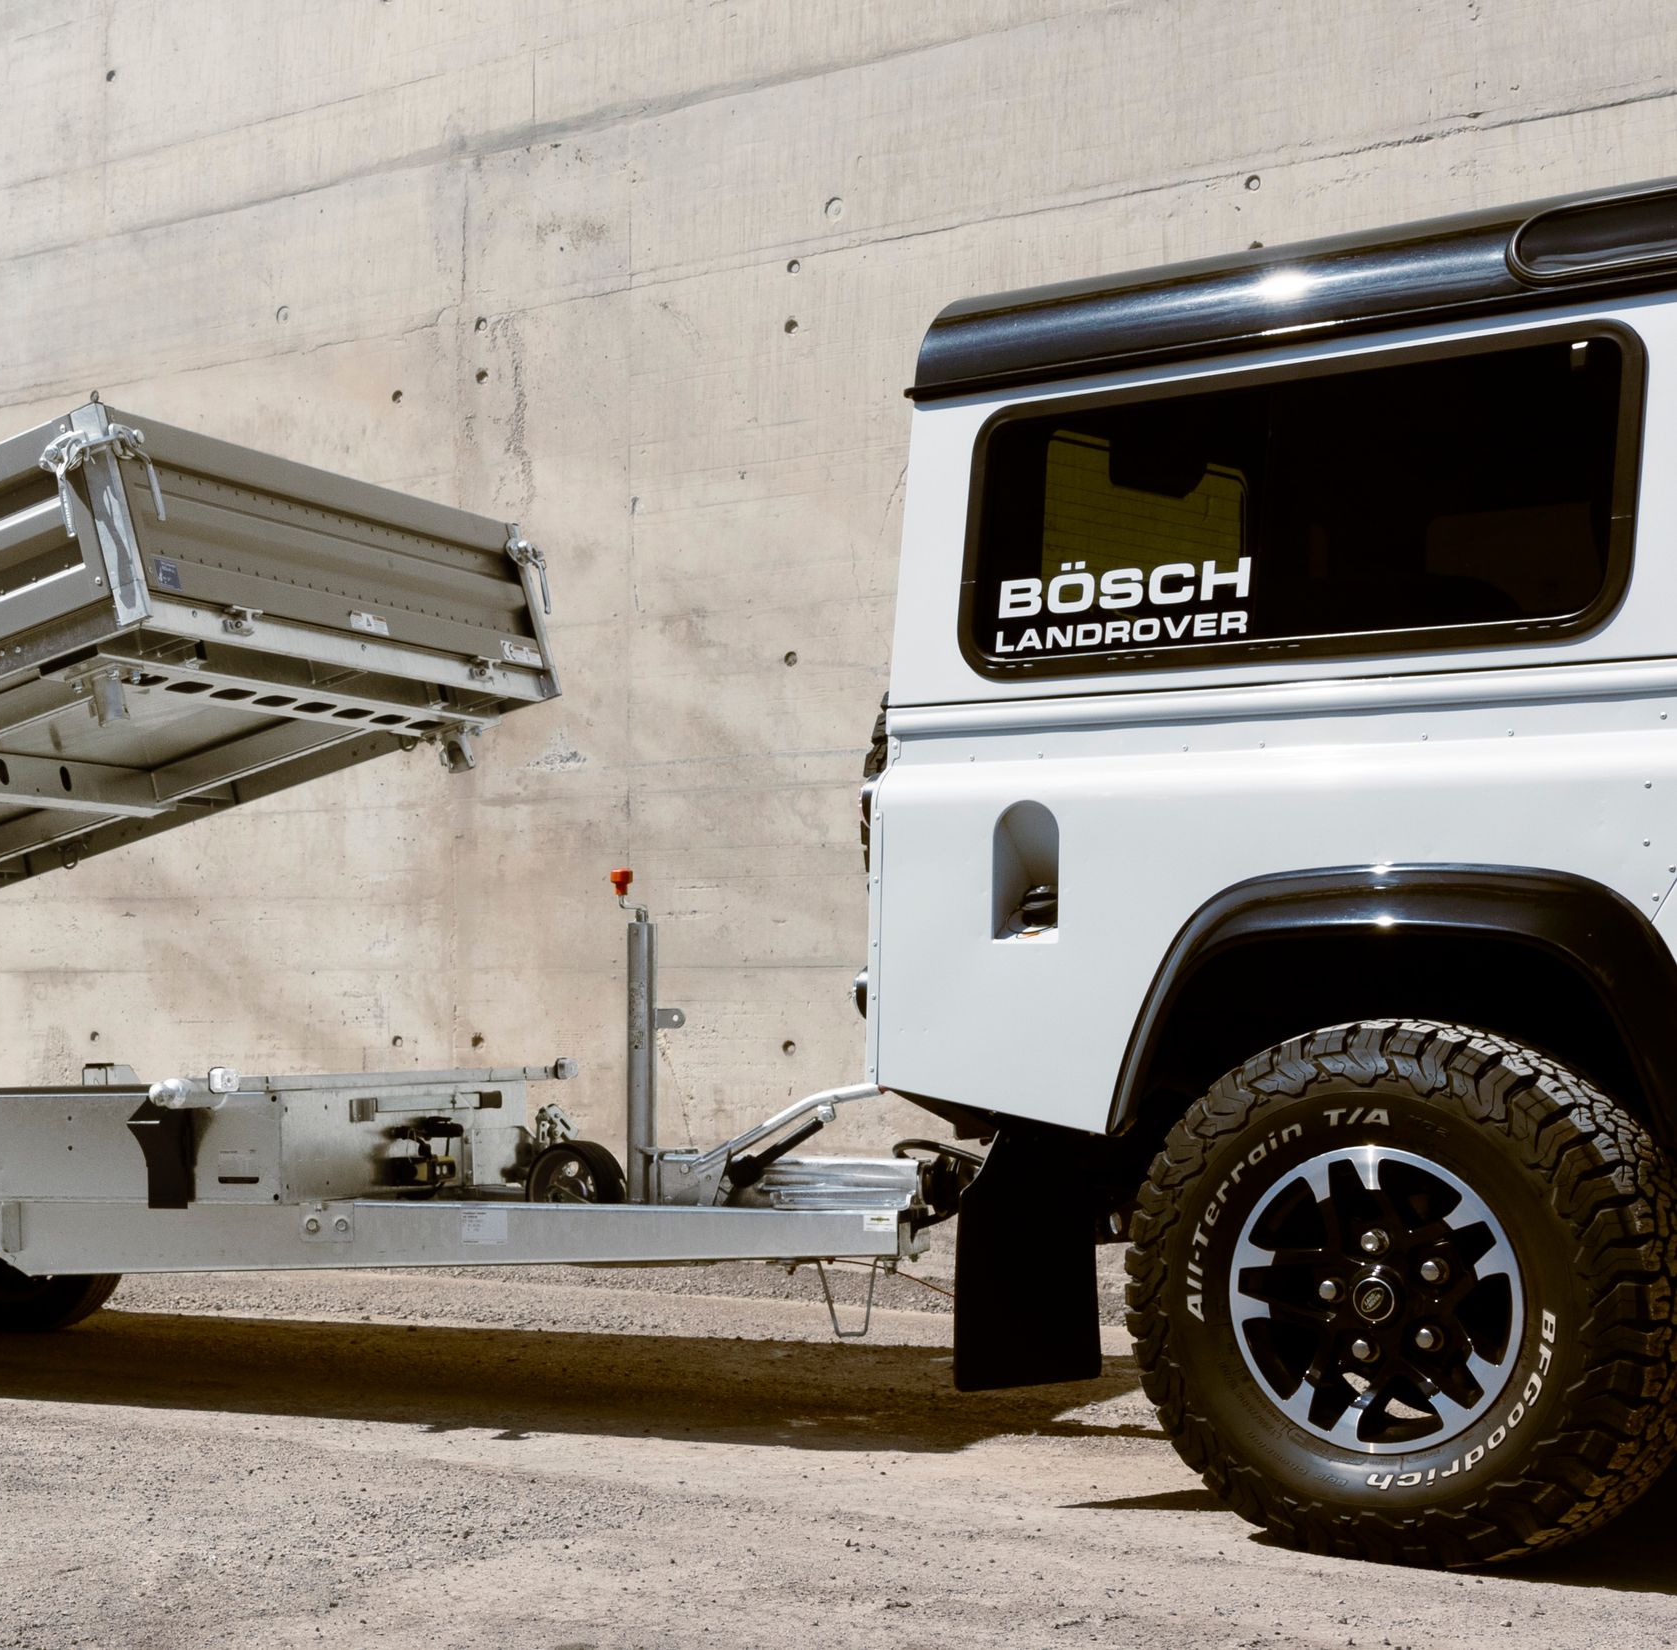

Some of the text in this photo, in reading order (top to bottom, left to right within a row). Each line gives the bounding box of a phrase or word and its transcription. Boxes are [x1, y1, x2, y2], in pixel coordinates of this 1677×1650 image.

[995, 610, 1248, 653] LANDROVER
[998, 556, 1252, 619] BÖSCH
[1186, 1106, 1390, 1322] All-Terrain T/A
[1366, 1308, 1556, 1490] BFGoodrich
